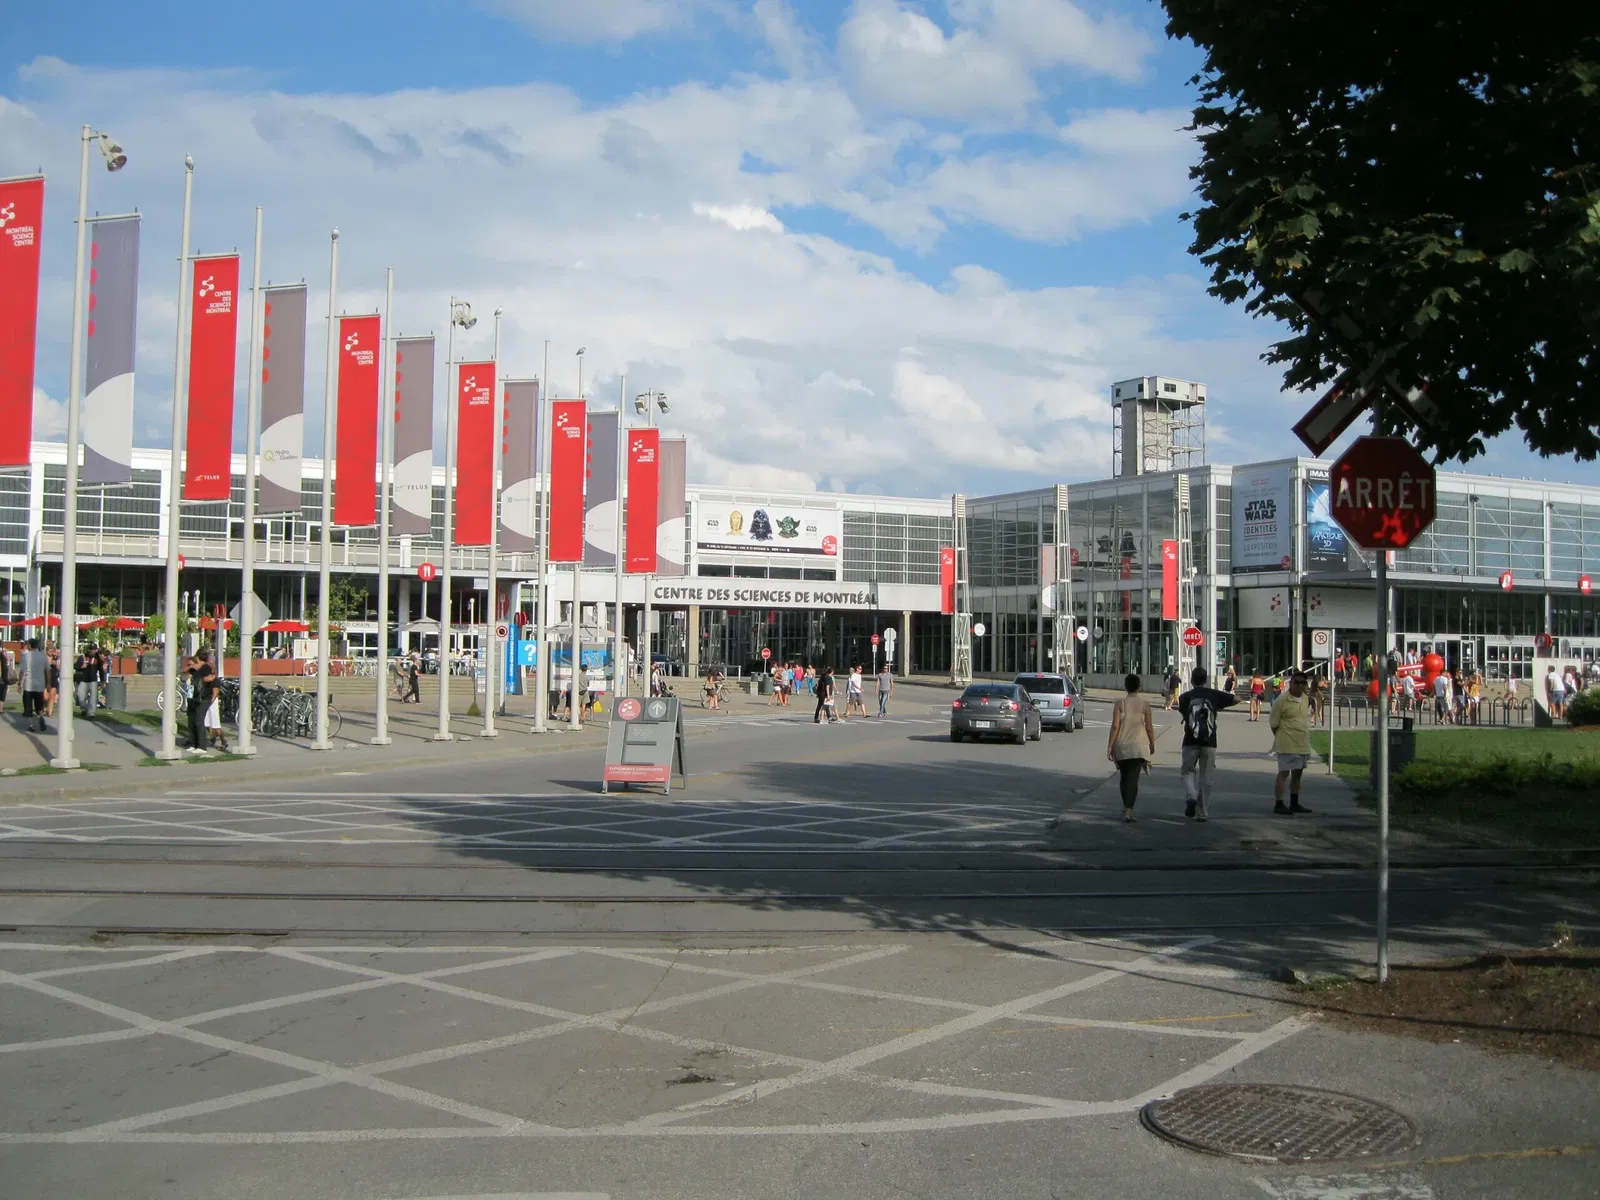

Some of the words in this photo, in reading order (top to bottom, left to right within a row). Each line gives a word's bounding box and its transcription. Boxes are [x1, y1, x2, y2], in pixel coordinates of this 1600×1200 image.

[12, 232, 34, 241] SCIENCE
[14, 239, 34, 247] CENTRE
[1309, 470, 1330, 478] IMAX
[1336, 471, 1431, 510] ARRÊT
[1244, 499, 1277, 512] STAR
[1244, 508, 1277, 521] WARS
[654, 587, 704, 600] CENTRE
[707, 588, 730, 601] DES
[734, 589, 792, 603] SCIENCES
[794, 591, 810, 604] DE
[813, 591, 879, 605] MONTRÉAL
[1183, 631, 1202, 641] ARRÊT
